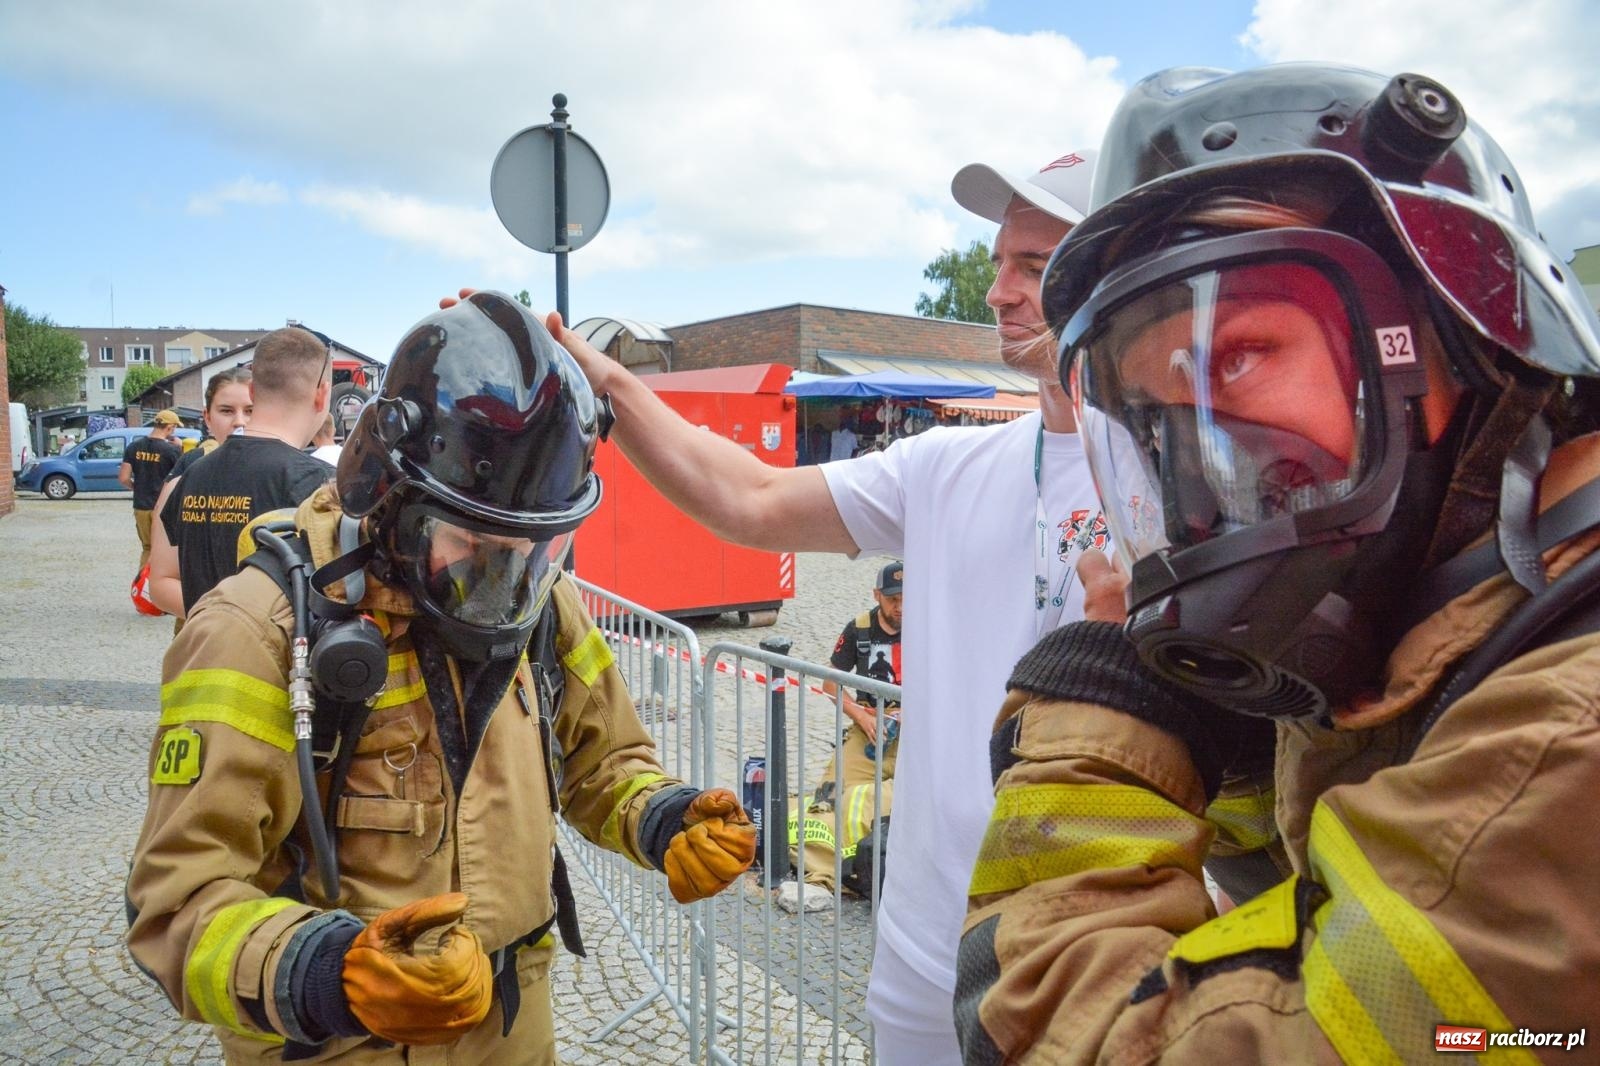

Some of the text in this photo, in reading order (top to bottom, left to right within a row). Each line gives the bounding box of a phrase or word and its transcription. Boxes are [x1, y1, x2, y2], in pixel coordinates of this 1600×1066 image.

[1383, 332, 1410, 358] 32
[207, 495, 252, 510] NAUKOWE
[752, 807, 763, 830] HAIX
